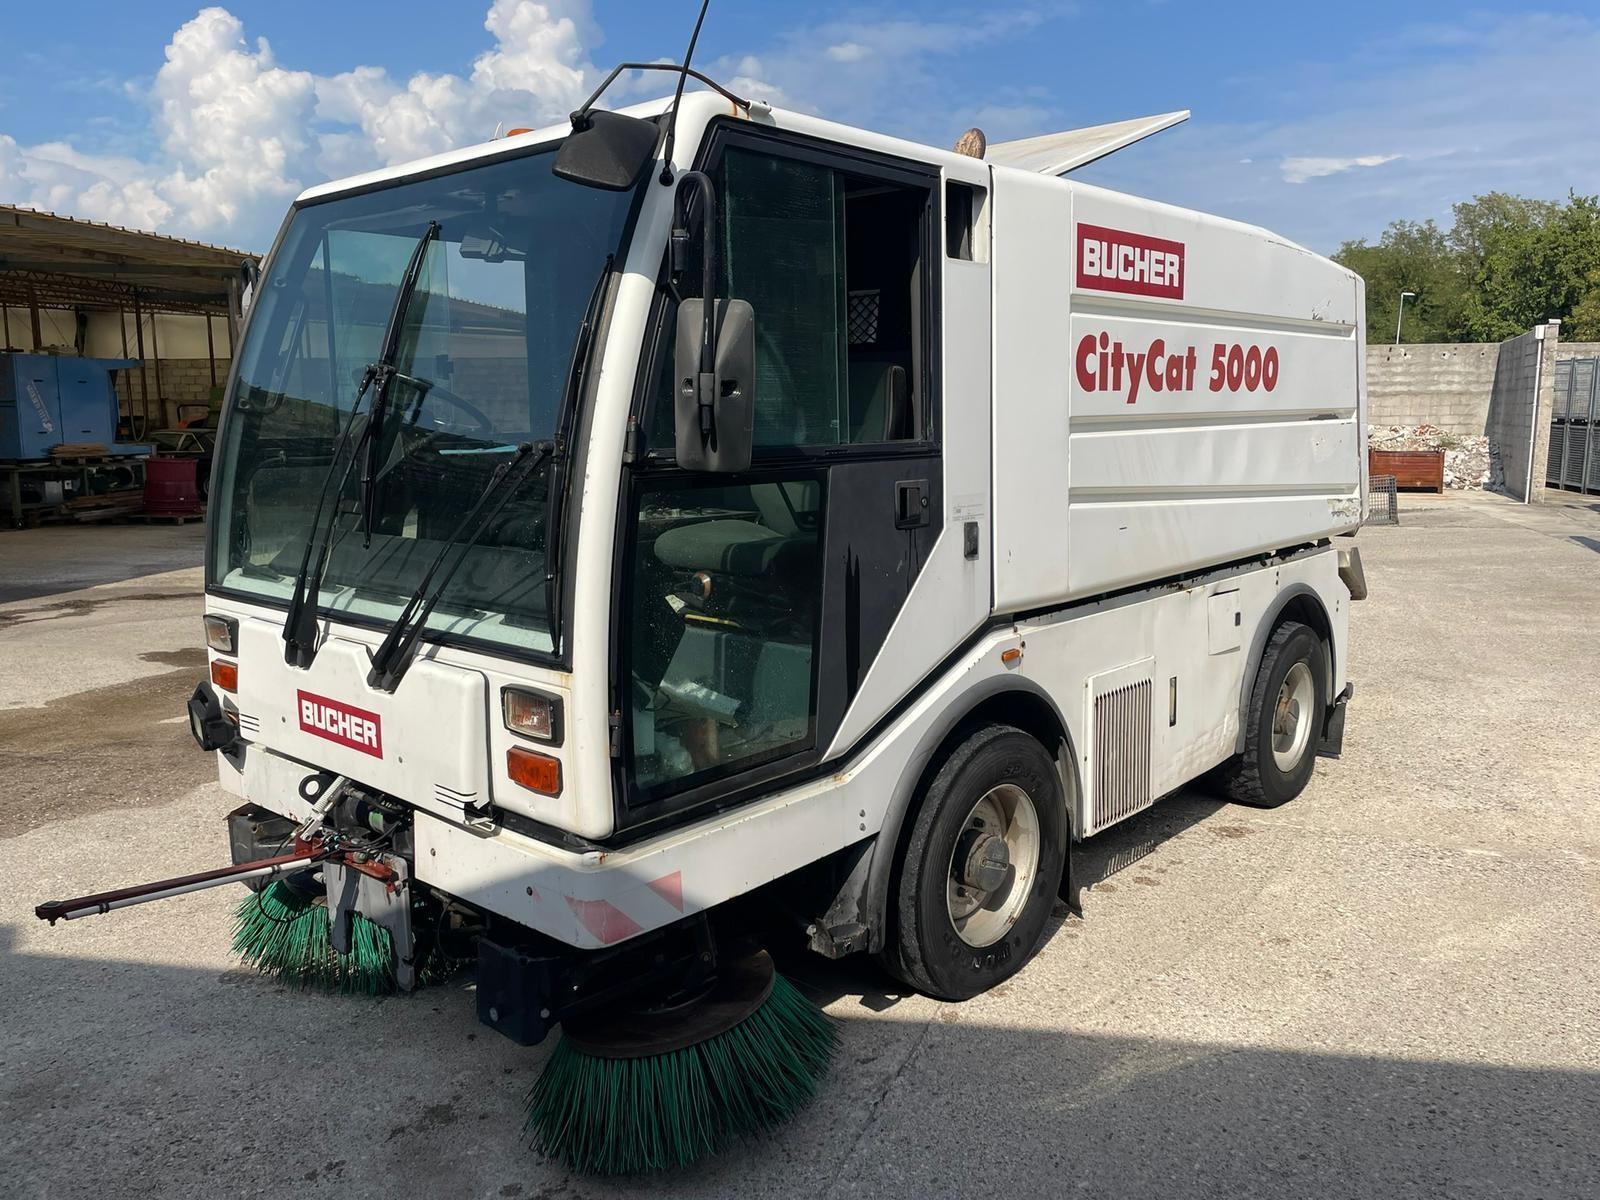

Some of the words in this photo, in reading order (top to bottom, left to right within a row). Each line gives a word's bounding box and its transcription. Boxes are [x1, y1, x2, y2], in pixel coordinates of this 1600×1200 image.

[1083, 238, 1180, 287] BUCHER
[1076, 331, 1197, 404] CityCat
[1208, 343, 1280, 392] 5000
[301, 699, 378, 749] BUCHER
